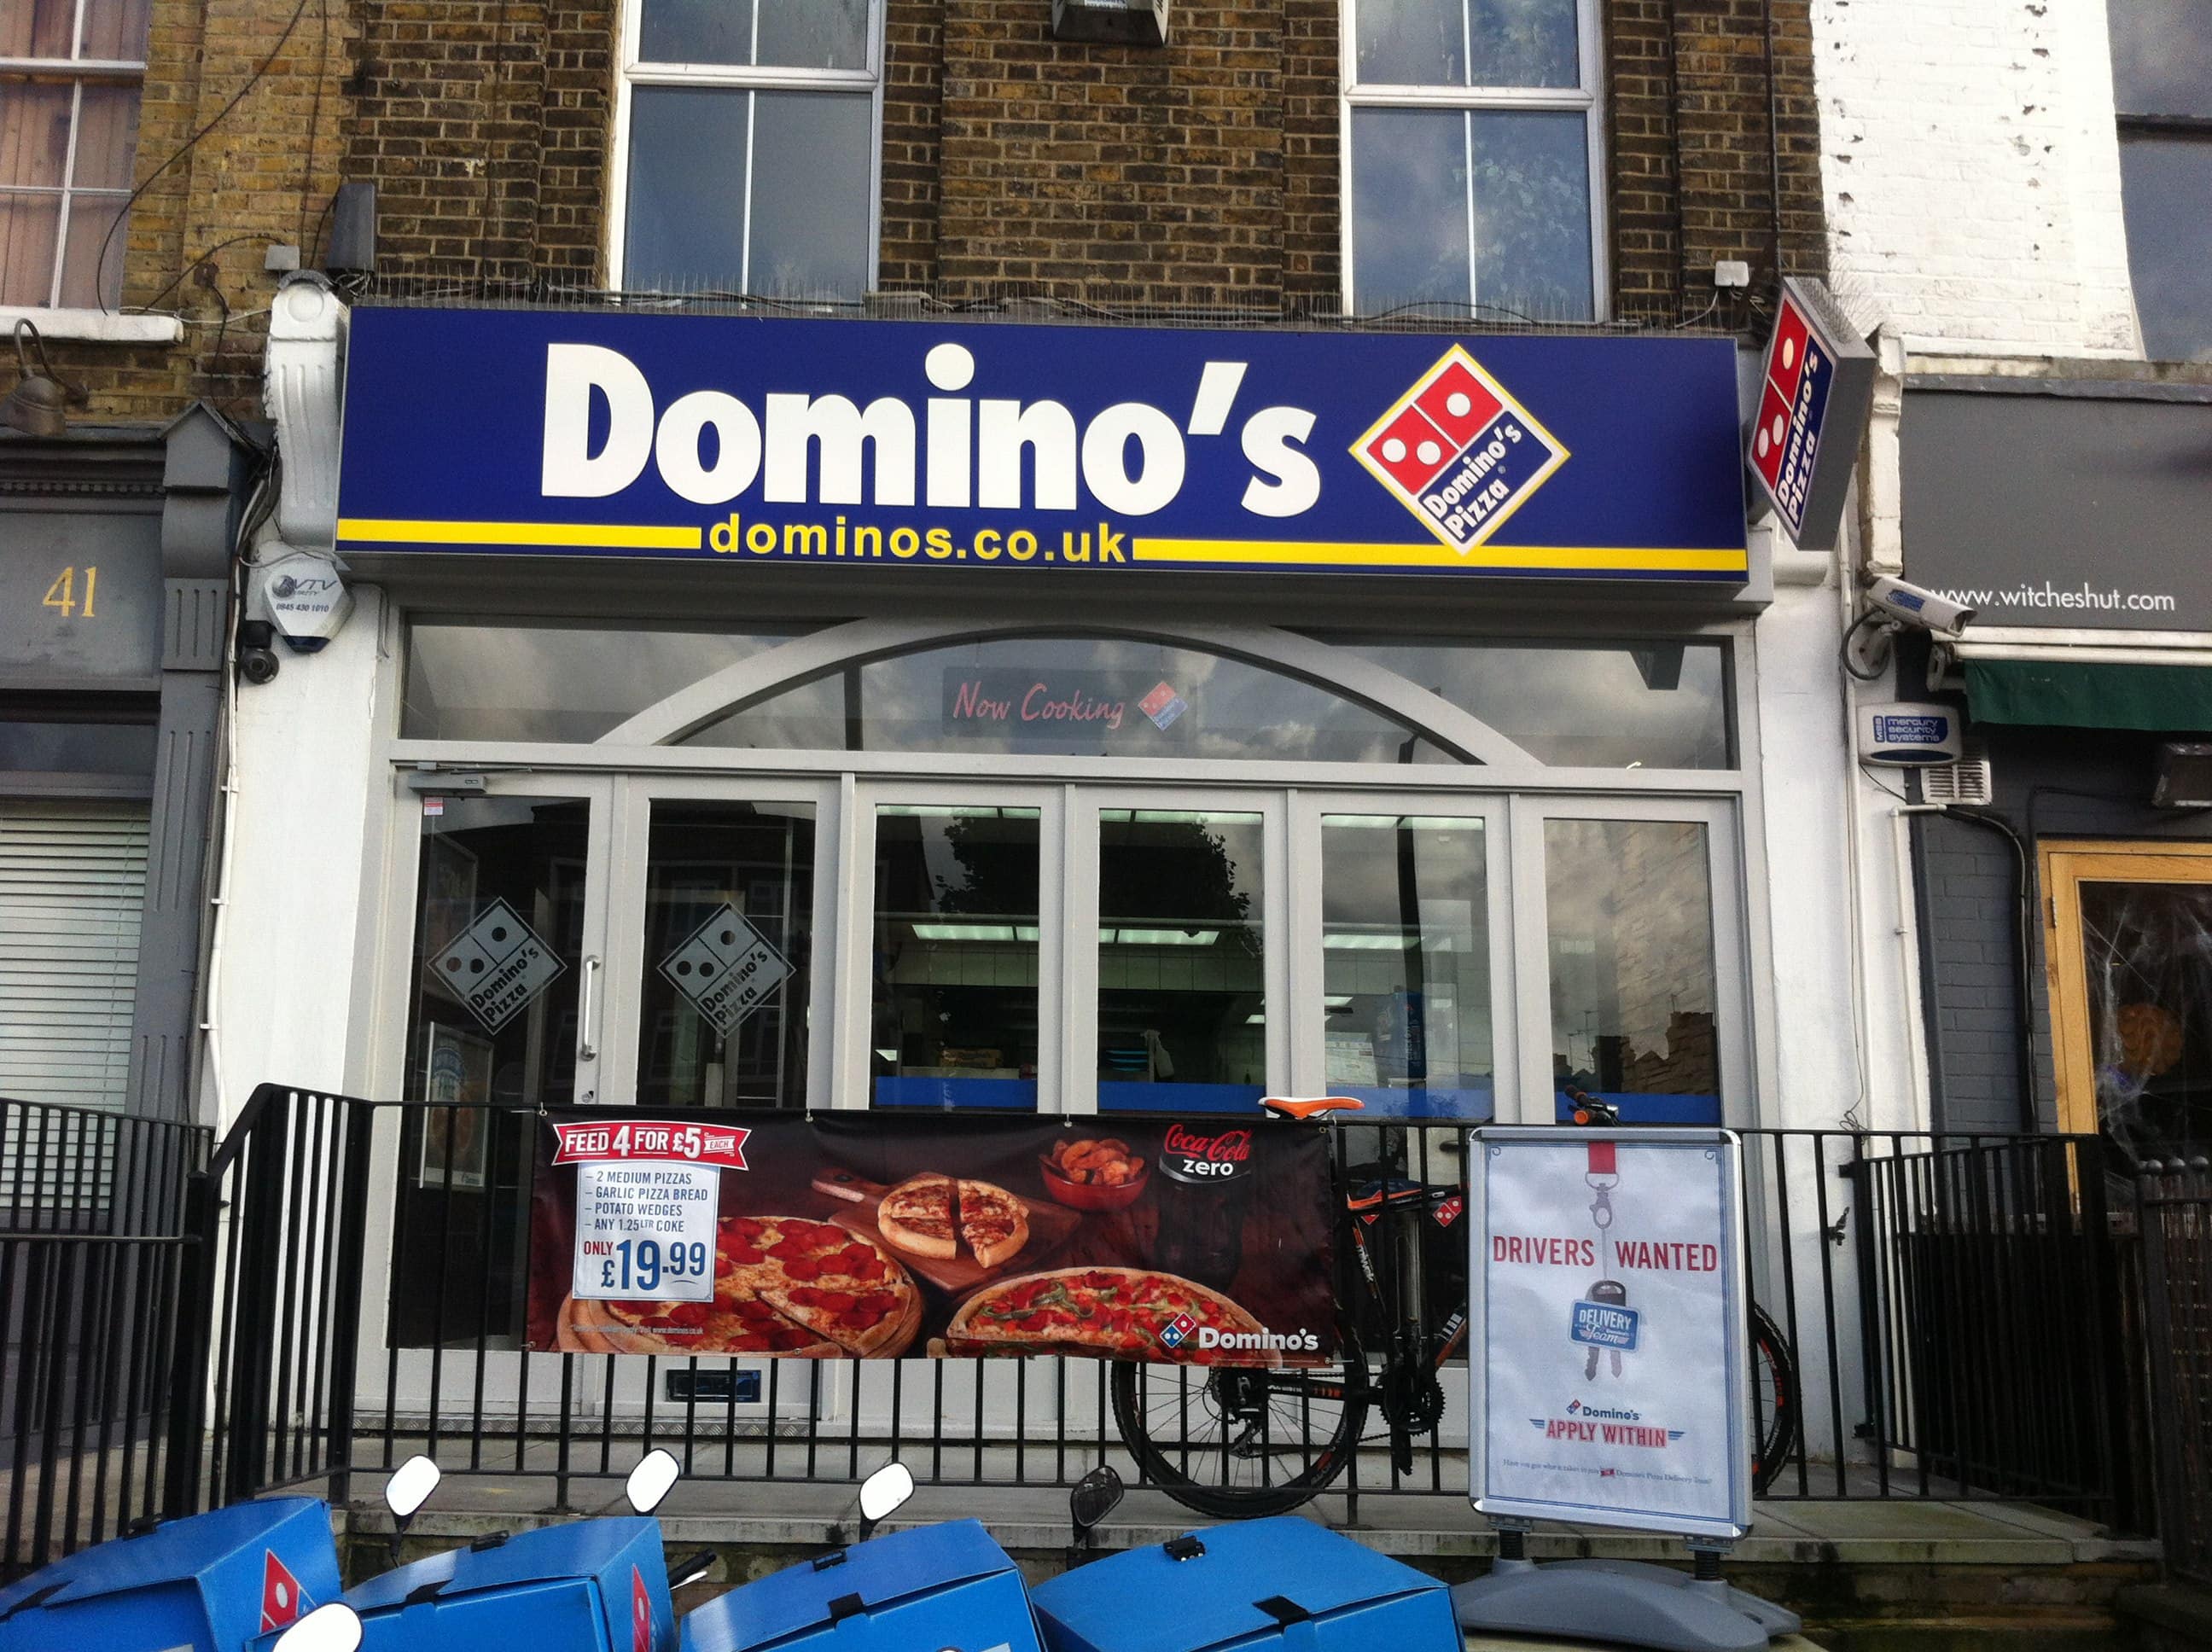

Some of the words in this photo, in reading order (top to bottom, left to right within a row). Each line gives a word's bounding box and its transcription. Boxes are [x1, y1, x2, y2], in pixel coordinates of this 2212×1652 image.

[542, 343, 1321, 517] Domino's
[1778, 350, 1819, 508] Domino's
[1423, 424, 1522, 519] Domino's
[1788, 429, 1818, 526] Pizza
[1444, 478, 1510, 540] Pizza
[709, 512, 1126, 563] dominos.co.uk
[43, 566, 96, 617] 41
[296, 603, 309, 612] 430
[311, 604, 329, 613] 1010
[952, 682, 1010, 719] Now
[1021, 683, 1126, 730] Cooking
[1888, 718, 1938, 727] mercury
[1889, 725, 1936, 735] security
[1889, 734, 1939, 742] systems
[470, 947, 539, 1010] Domino's
[700, 949, 768, 1014] Domino's
[483, 983, 527, 1023] Pizza
[717, 986, 757, 1026] Pizza
[564, 1131, 610, 1153] FEED
[613, 1126, 631, 1157] 4
[633, 1130, 669, 1151] FOR
[672, 1127, 701, 1160] £5
[710, 1140, 729, 1149] EACH
[1164, 1123, 1254, 1161] Coca-Cola
[597, 1171, 604, 1183] 2
[607, 1172, 651, 1184] MEDIUM
[655, 1172, 692, 1185] PIZZAS
[1183, 1159, 1234, 1177] zero
[595, 1202, 634, 1215] POTATO
[637, 1204, 683, 1217] WEDGES
[596, 1186, 635, 1199] GARLIC
[639, 1188, 670, 1201] PIZZA
[673, 1189, 708, 1201] BREAD
[594, 1218, 615, 1230] ANY
[656, 1219, 684, 1232] COKE
[584, 1241, 614, 1256] ONLY
[601, 1239, 706, 1291] £19.99
[1493, 1236, 1595, 1266] DRIVERS
[1615, 1241, 1717, 1271] WANTED
[1579, 1309, 1632, 1330] DELIVERY
[1586, 1323, 1619, 1344] Team
[1198, 1327, 1318, 1350] Domino's
[1582, 1406, 1639, 1421] Domino's
[1546, 1420, 1598, 1442] APPLY
[1601, 1424, 1667, 1447] WITHIN
